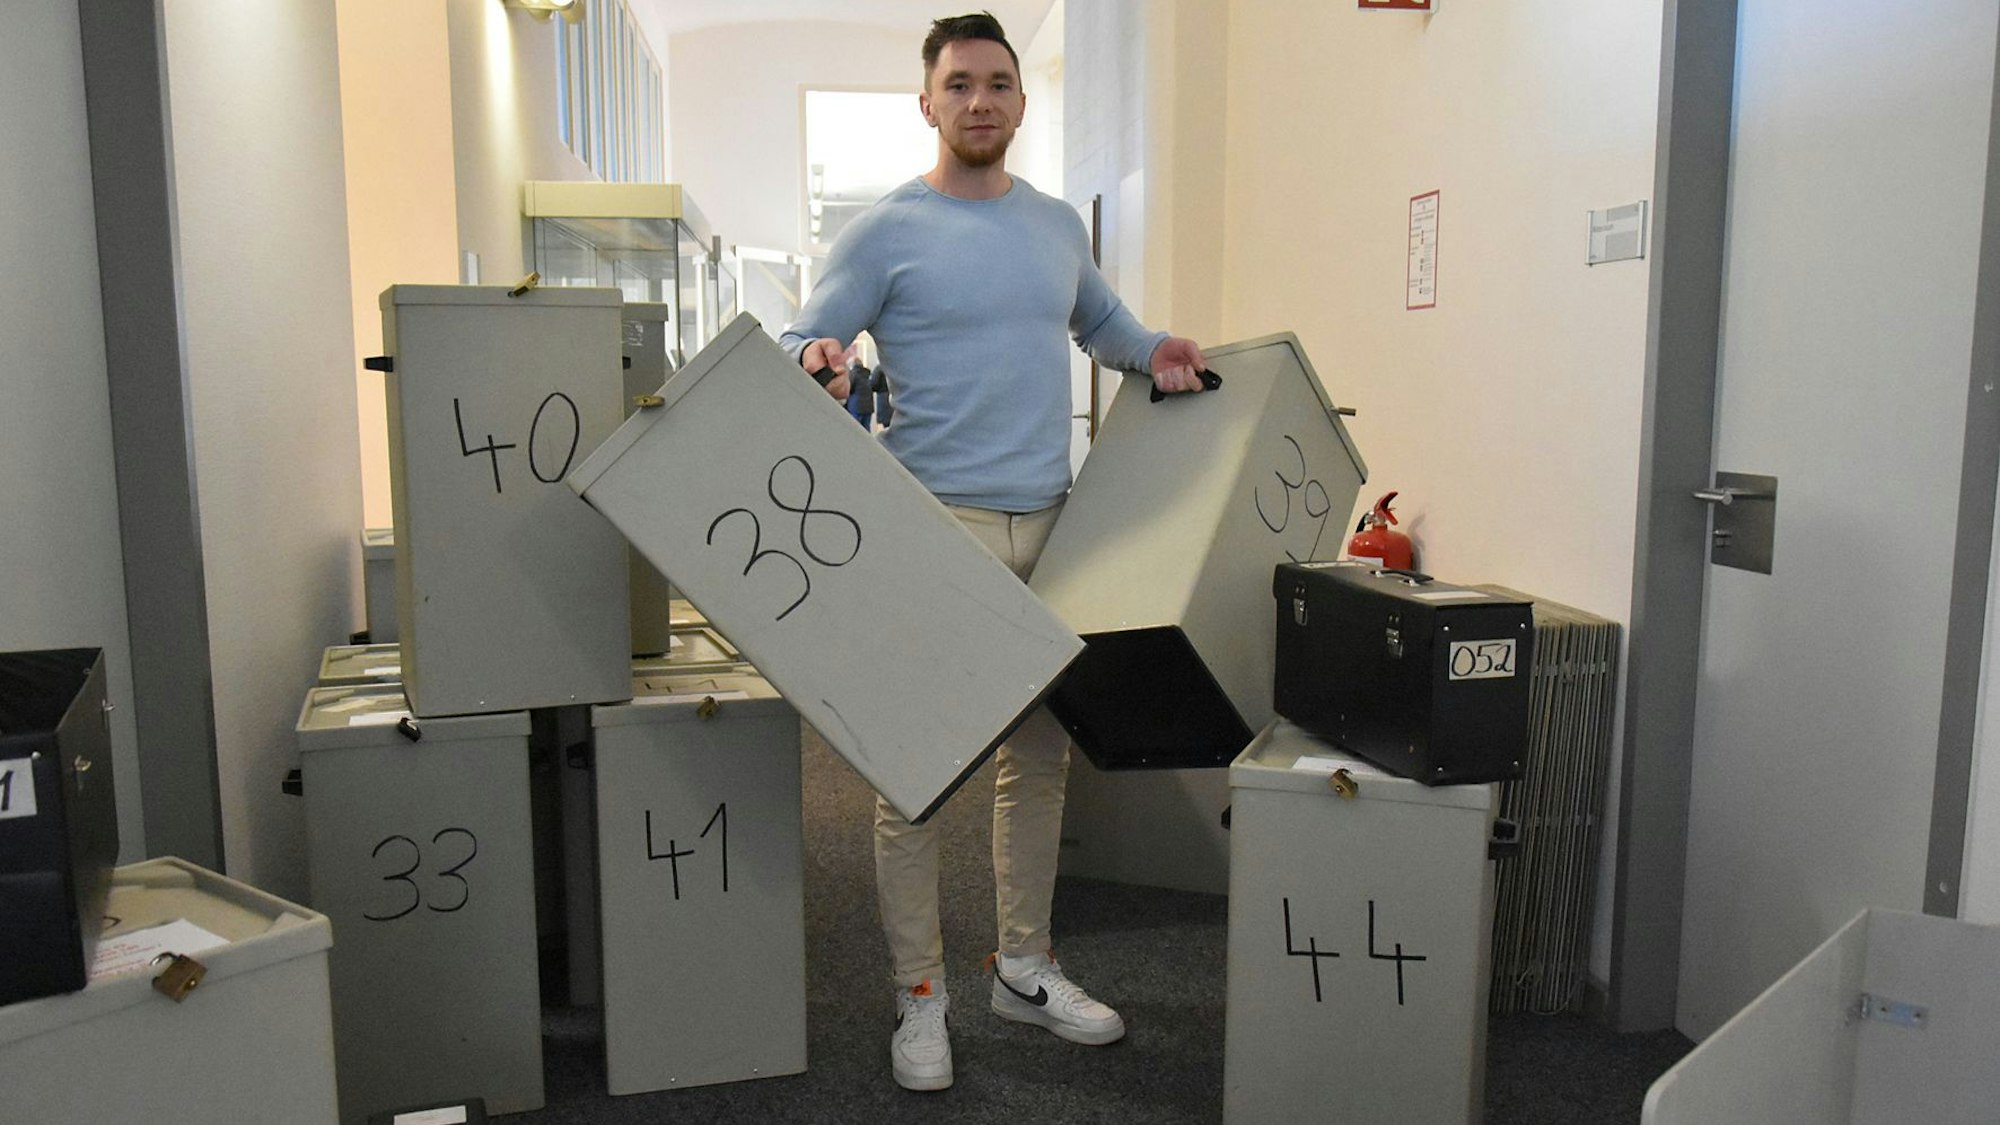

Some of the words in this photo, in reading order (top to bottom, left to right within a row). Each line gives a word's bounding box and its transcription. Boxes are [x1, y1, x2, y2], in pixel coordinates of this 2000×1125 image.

[454, 392, 579, 493] 40
[707, 455, 861, 621] 38
[1255, 435, 1331, 562] 39
[363, 828, 477, 921] 33
[645, 802, 728, 900] 41
[1283, 898, 1426, 1005] 44
